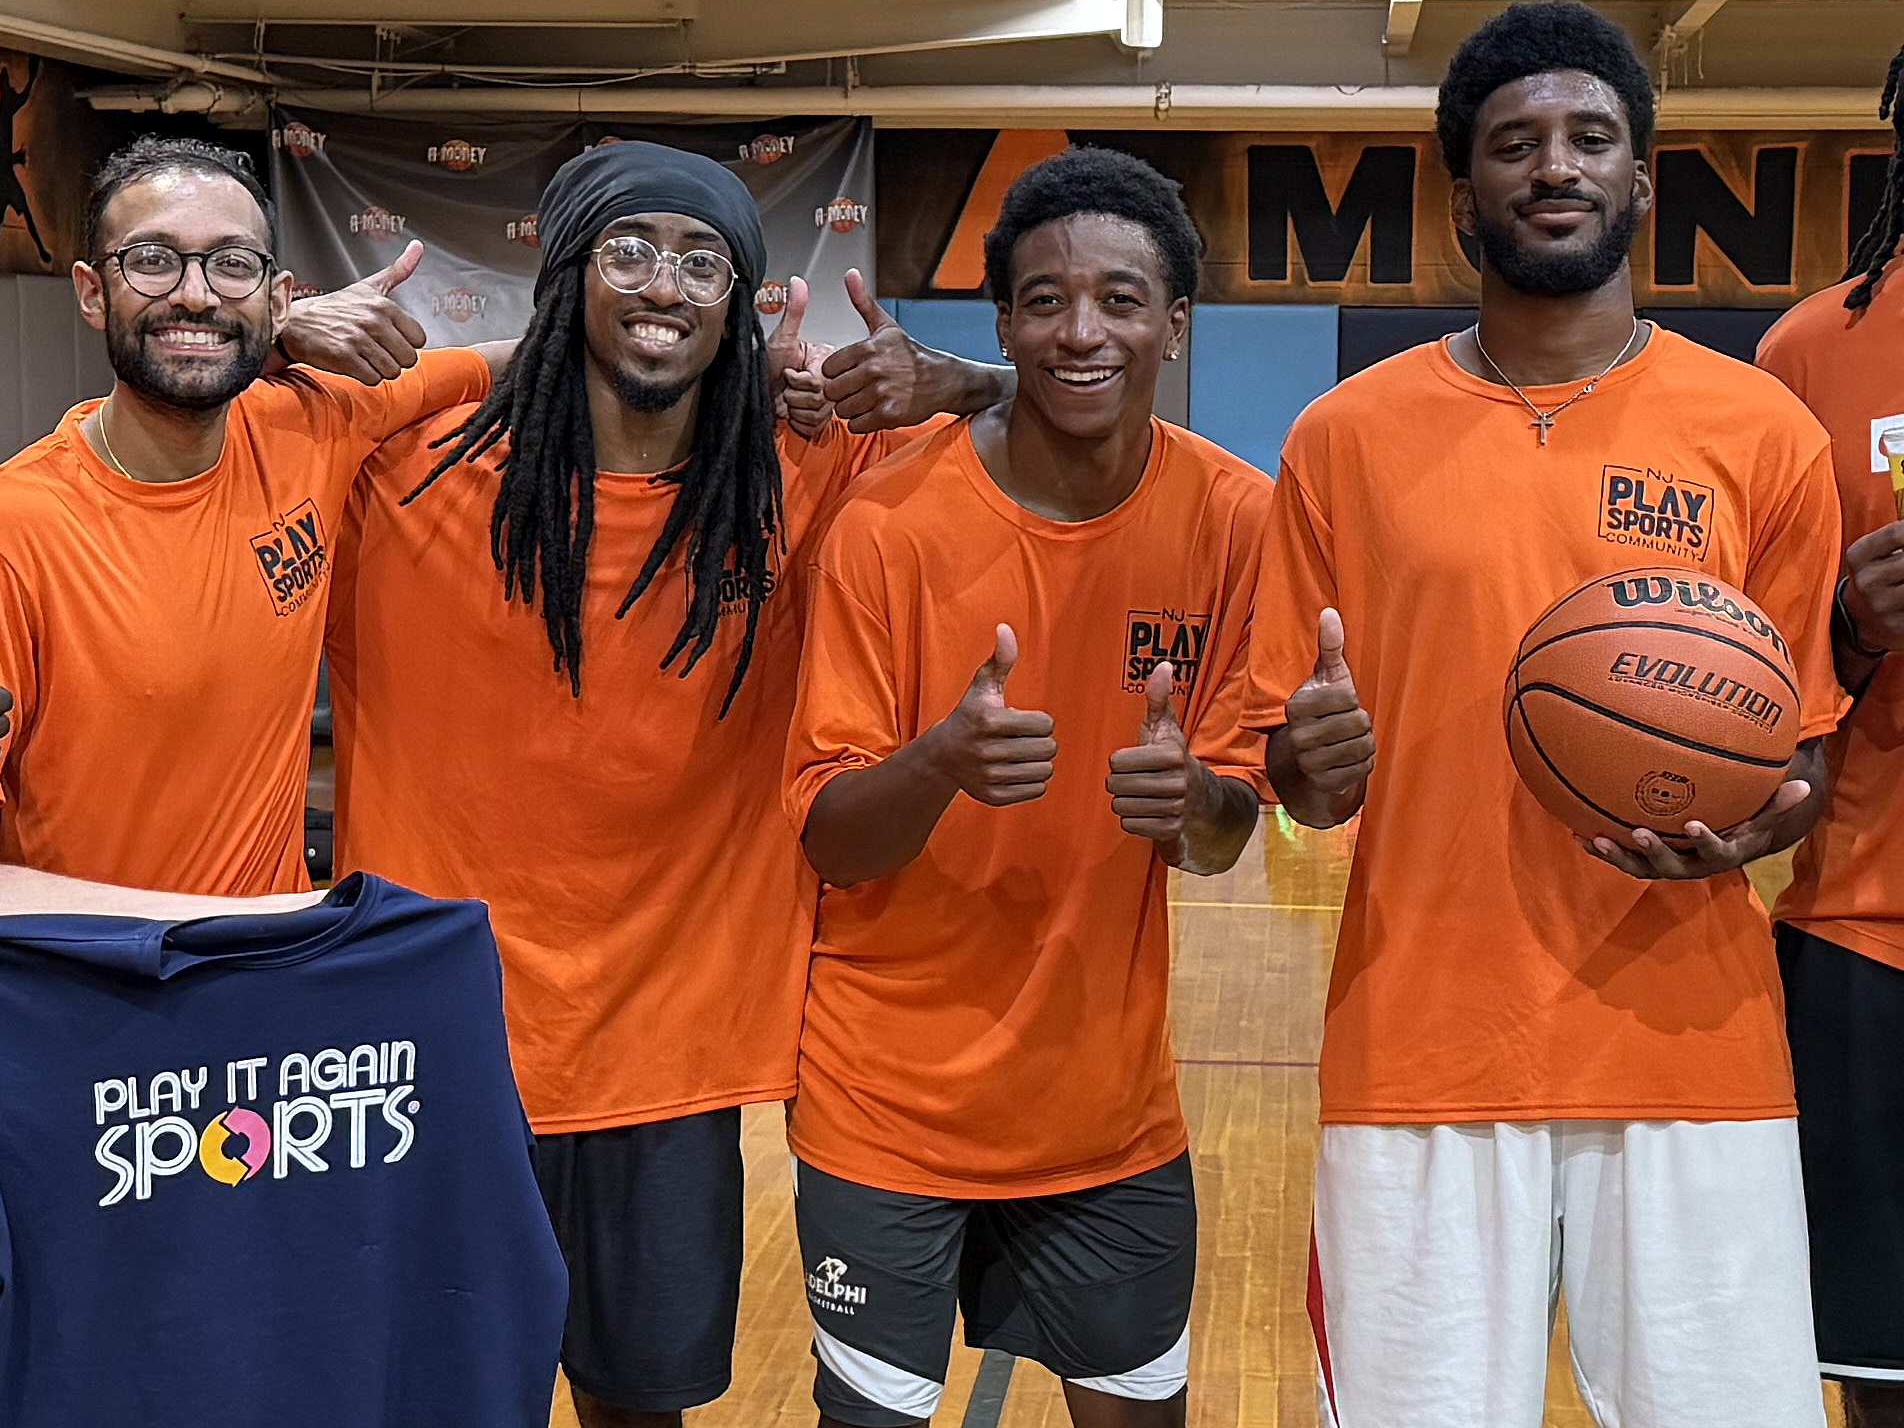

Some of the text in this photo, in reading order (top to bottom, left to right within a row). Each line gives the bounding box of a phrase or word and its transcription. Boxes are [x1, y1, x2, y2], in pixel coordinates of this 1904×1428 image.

[1647, 467, 1674, 483] NJ
[1607, 475, 1707, 523] PLAY
[256, 511, 319, 580] PLAY
[1606, 507, 1705, 549] SPORTS
[1606, 532, 1700, 562] COMMUNITY
[273, 544, 327, 603] SPORTS
[1161, 607, 1185, 622] NJ
[1130, 621, 1207, 659] PLAY
[1127, 656, 1198, 682] SPRT
[1609, 651, 1783, 728] EVOLUTION
[94, 1040, 416, 1125] PLAY IT AGAIN
[807, 1273, 868, 1305] DELPHI
